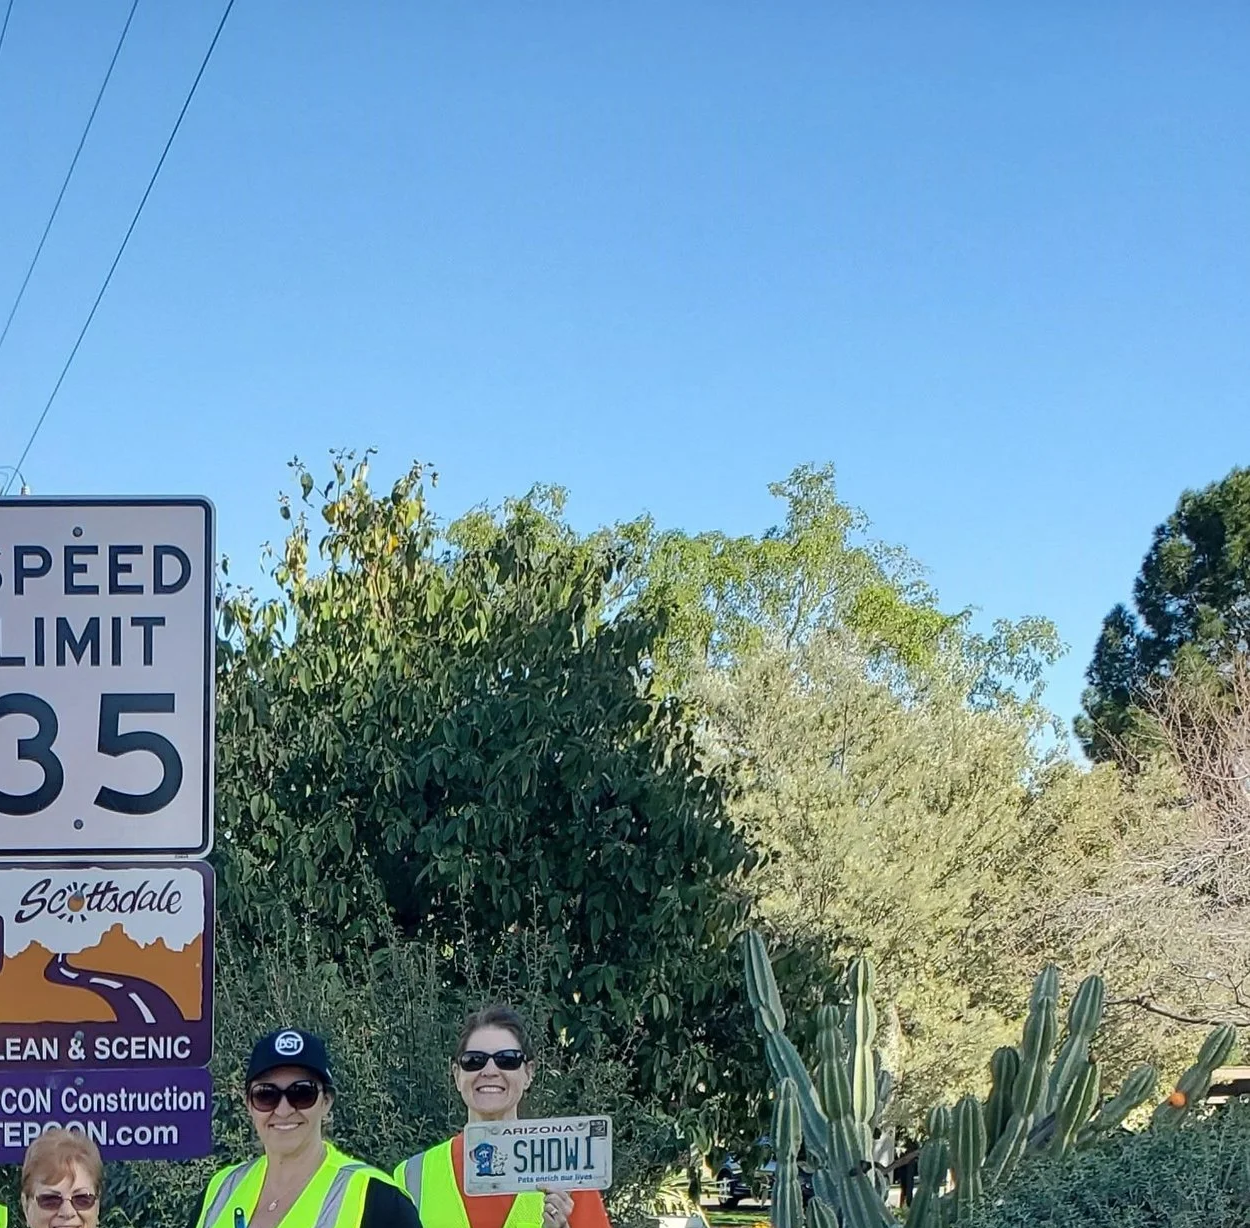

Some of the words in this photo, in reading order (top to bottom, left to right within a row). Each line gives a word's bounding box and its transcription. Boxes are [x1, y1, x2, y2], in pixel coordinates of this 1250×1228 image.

[67, 1037, 86, 1060] &
[94, 1035, 191, 1059] SCENIC
[61, 1086, 206, 1113] Construction
[502, 1125, 574, 1136] ARIZONA
[518, 1176, 534, 1184] Pets
[536, 1174, 559, 1182] enrich
